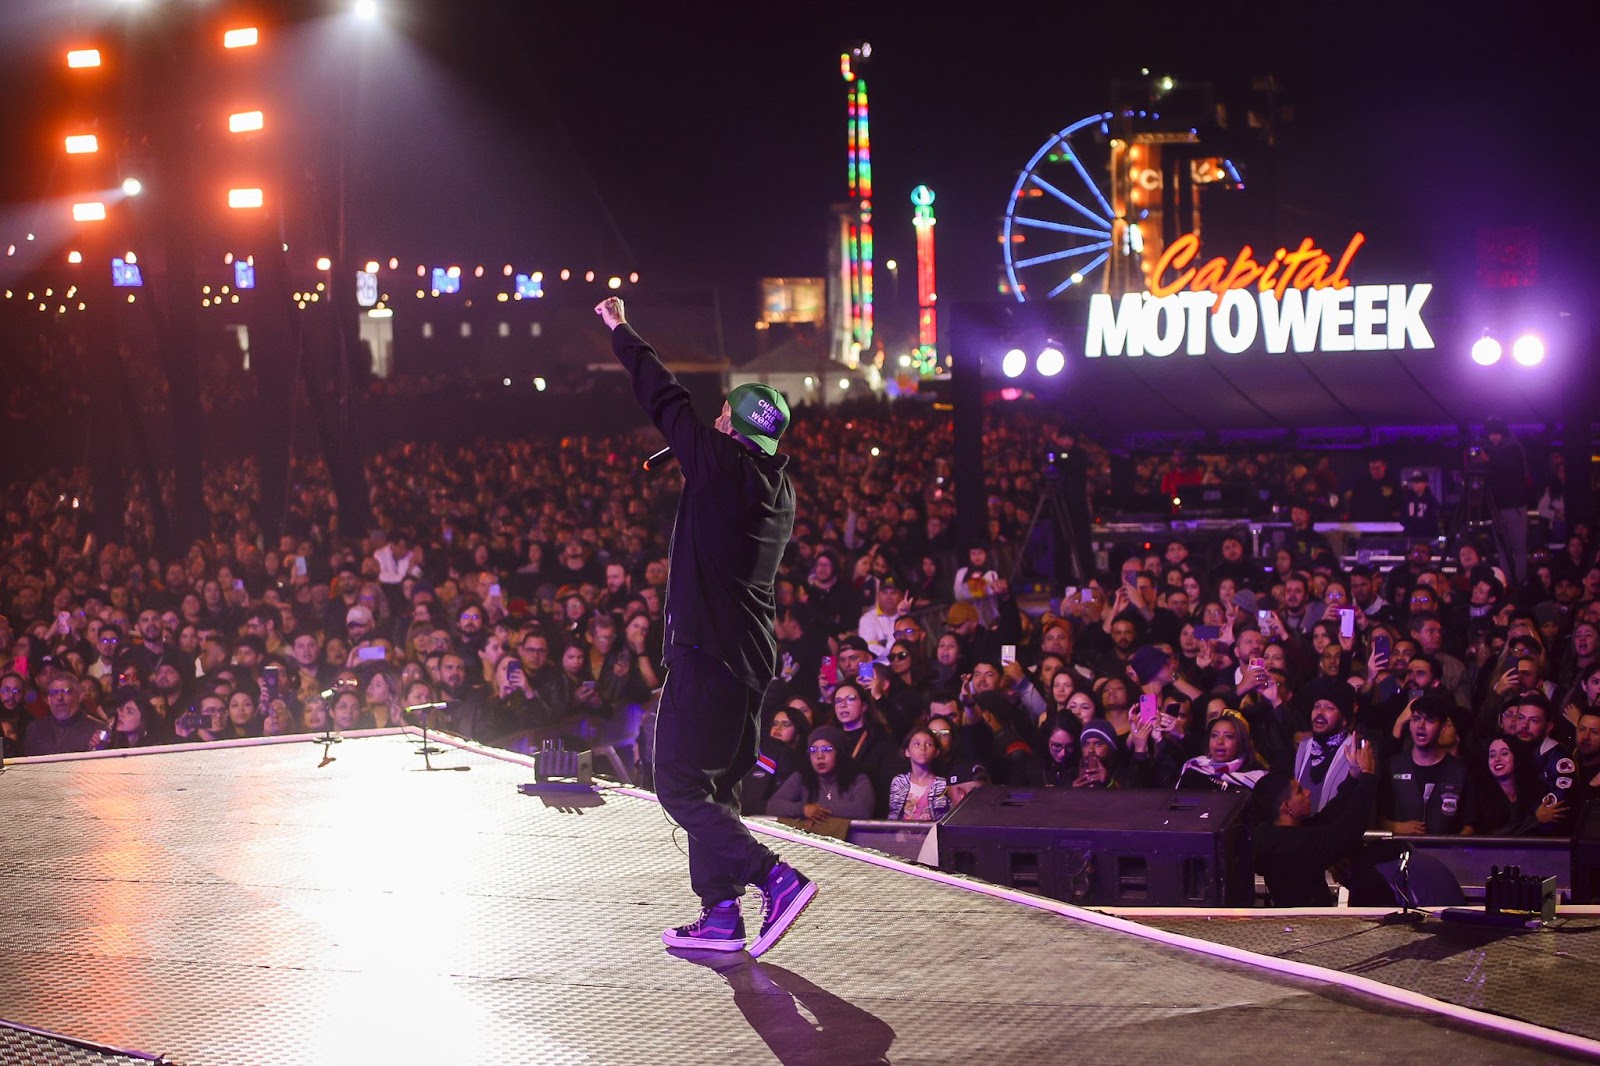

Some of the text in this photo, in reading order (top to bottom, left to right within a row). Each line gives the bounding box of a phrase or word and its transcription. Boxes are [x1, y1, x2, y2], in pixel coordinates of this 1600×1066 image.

[1149, 232, 1365, 314] Capital
[751, 411, 776, 432] WORLD
[761, 410, 776, 424] THE
